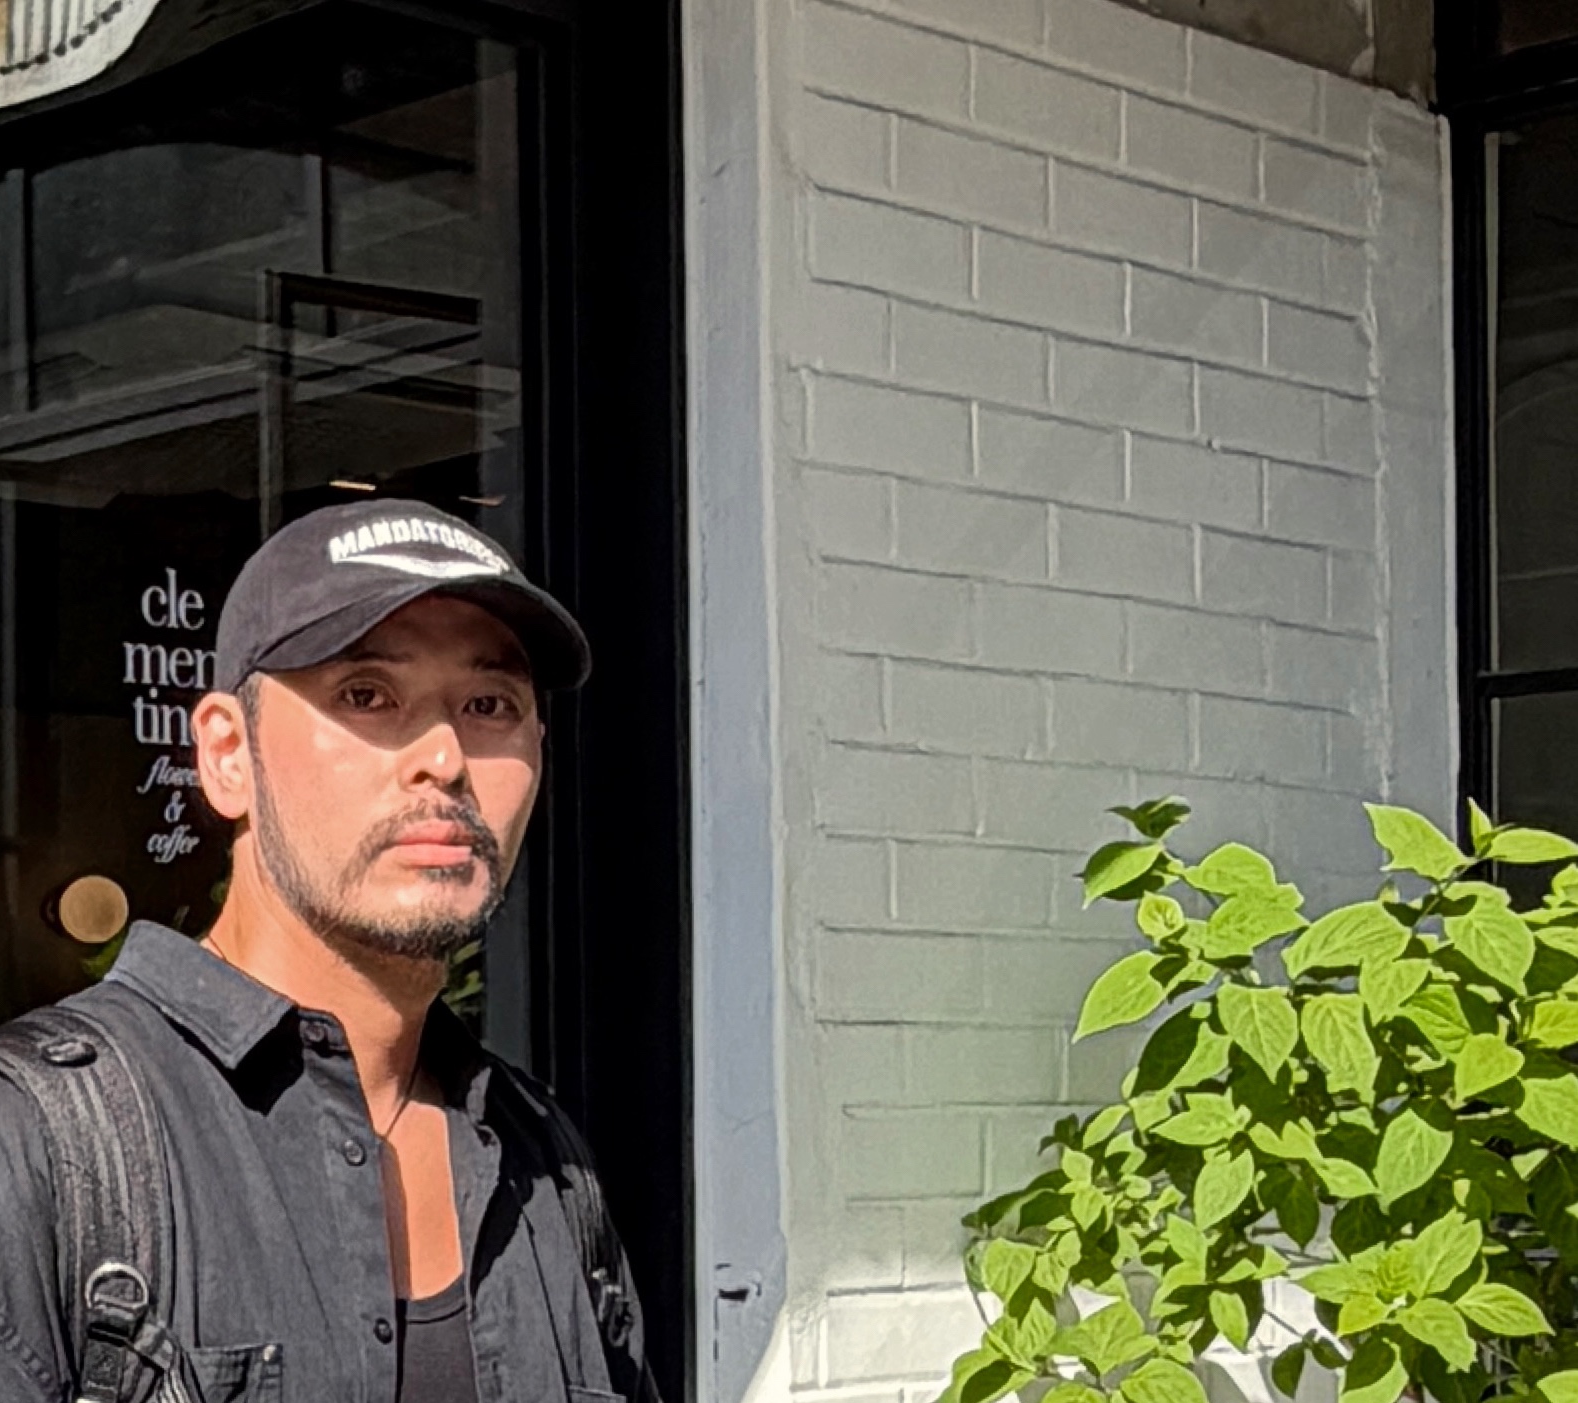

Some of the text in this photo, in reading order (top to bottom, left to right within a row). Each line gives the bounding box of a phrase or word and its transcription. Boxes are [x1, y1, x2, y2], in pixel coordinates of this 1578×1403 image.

[141, 566, 205, 630] cle
[133, 687, 194, 746] tin
[136, 755, 201, 794] flowe
[164, 790, 186, 823] &
